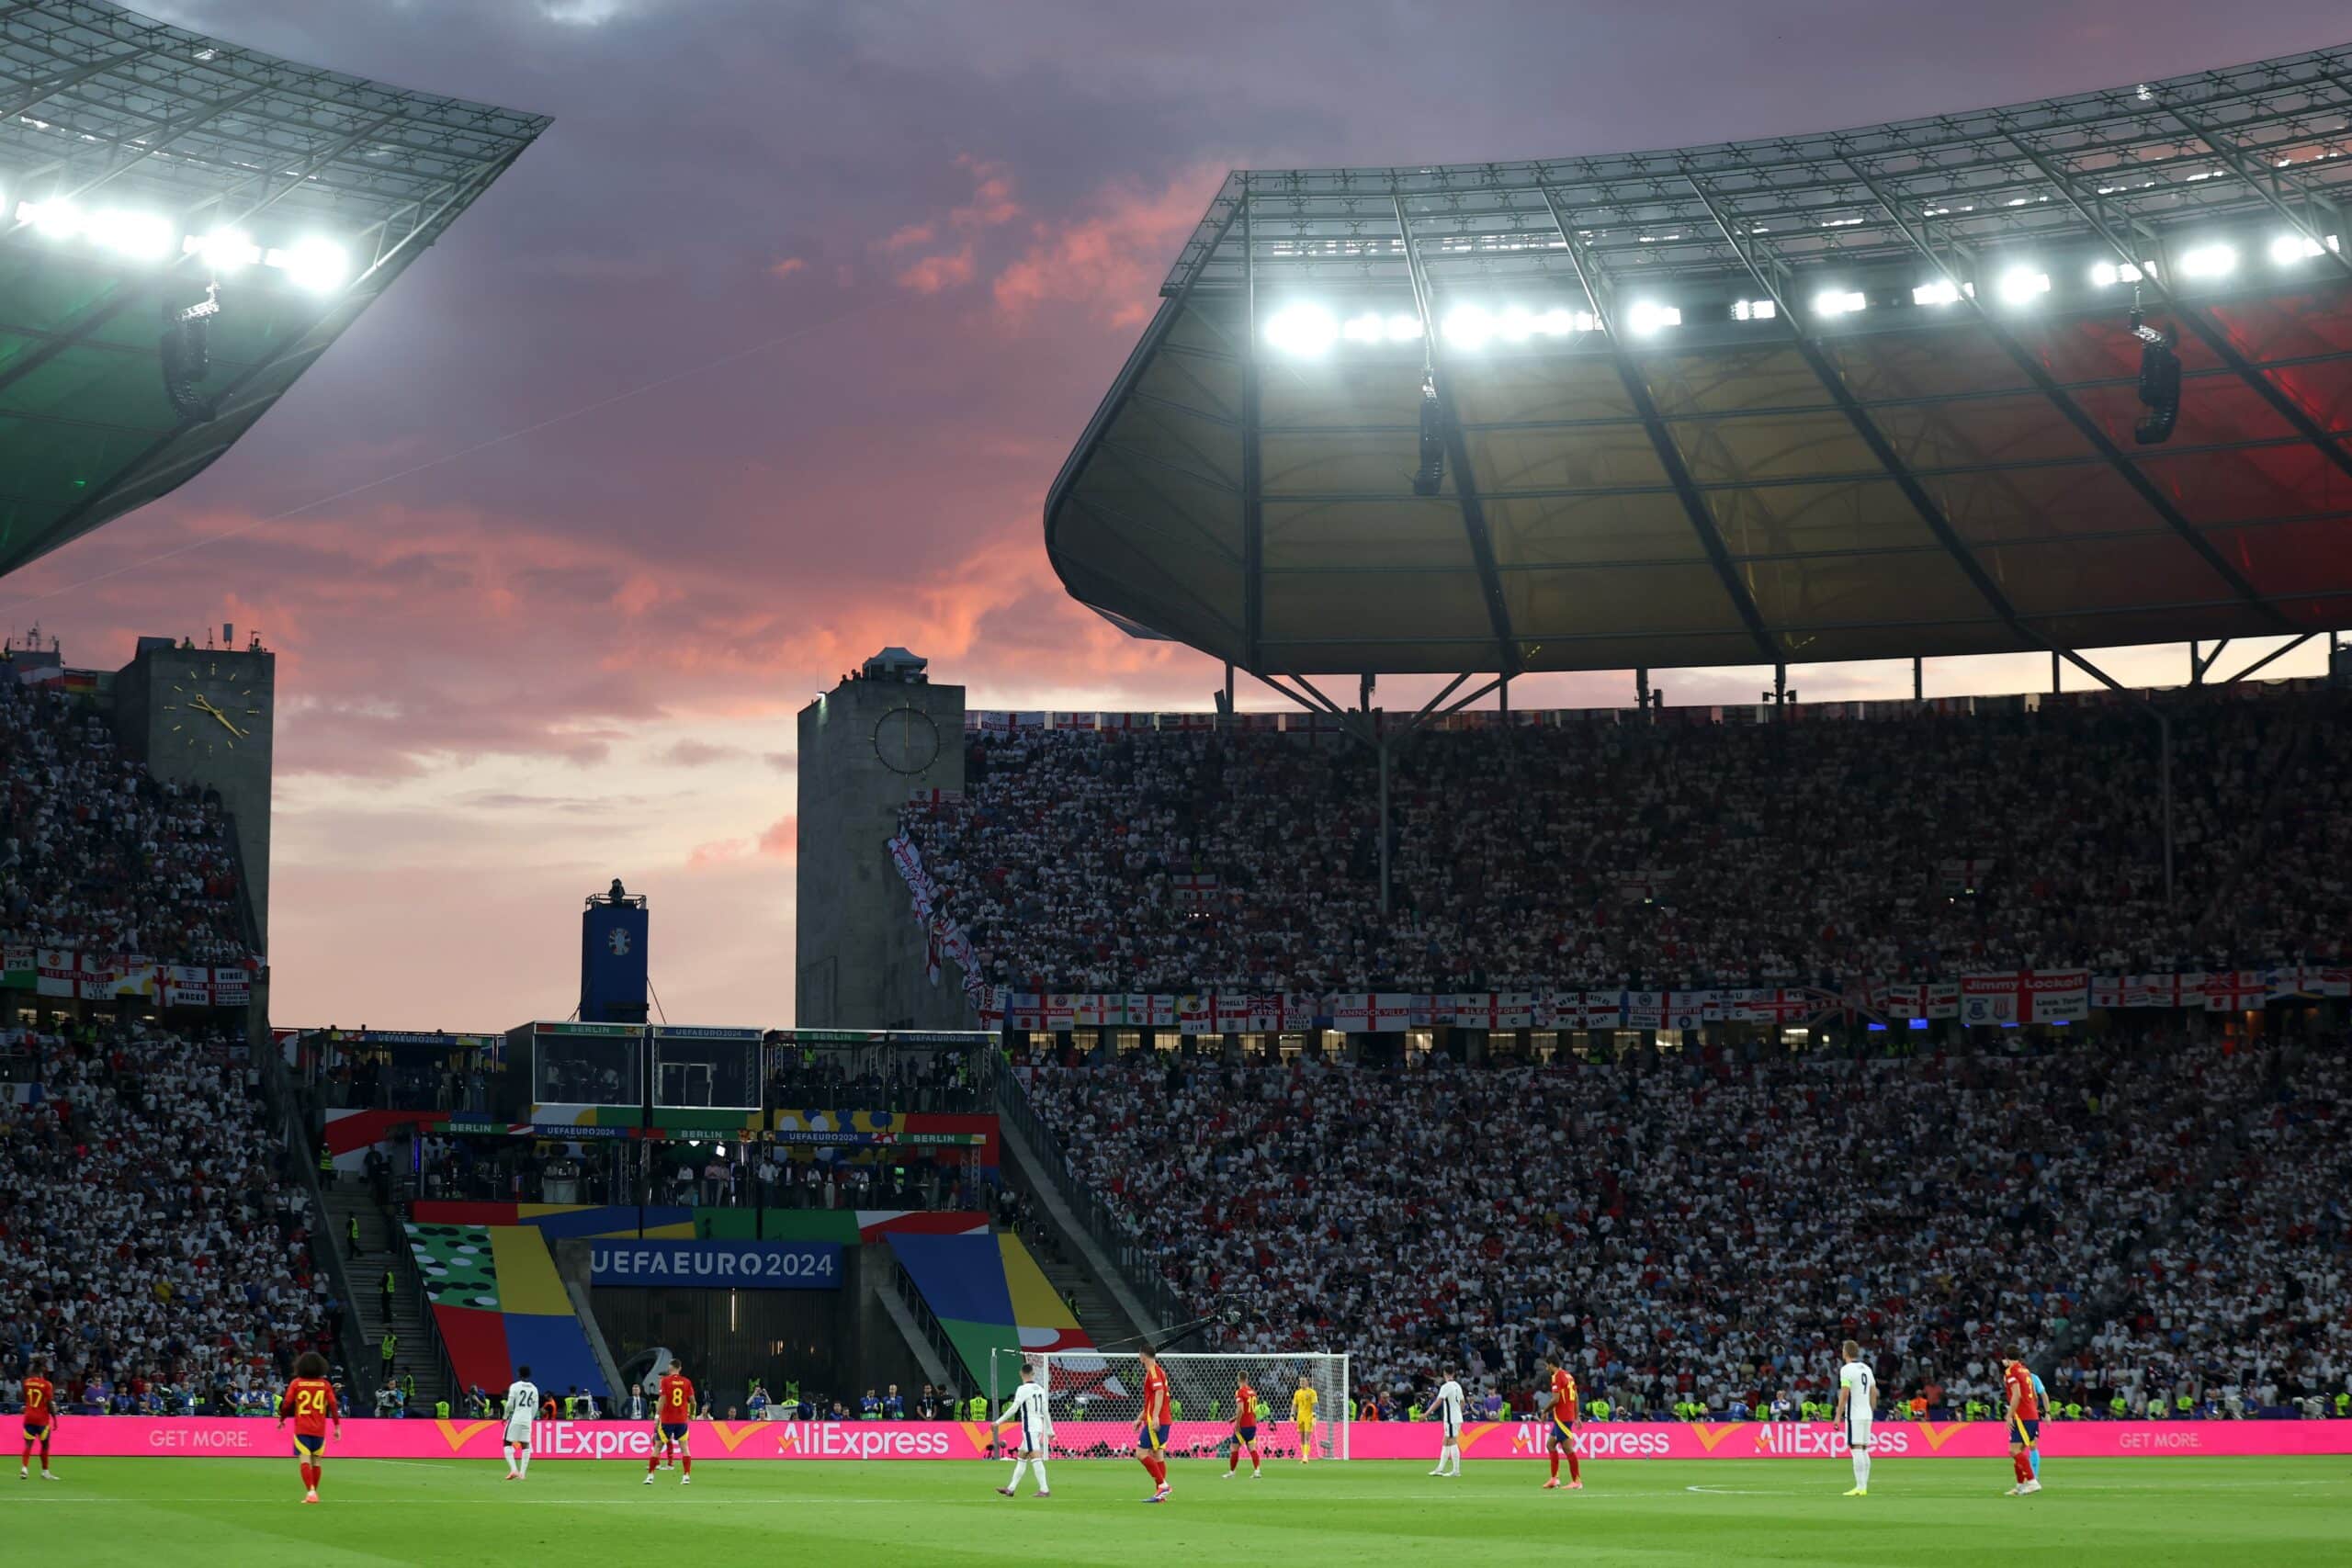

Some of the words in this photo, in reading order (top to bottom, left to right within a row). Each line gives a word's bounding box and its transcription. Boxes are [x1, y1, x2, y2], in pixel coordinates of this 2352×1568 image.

[571, 1025, 611, 1034] BERLIN
[812, 1032, 853, 1041] BERLIN
[449, 1123, 492, 1133] BERLIN
[681, 1130, 723, 1139] BERLIN
[912, 1134, 956, 1144] BERLIN
[1860, 1372, 1868, 1394] 9
[27, 1388, 43, 1408] 17
[297, 1390, 326, 1416] 24
[518, 1390, 534, 1407] 26
[672, 1387, 684, 1407] 8
[1032, 1393, 1044, 1413] 11
[1248, 1395, 1258, 1414] 10
[149, 1429, 189, 1448] GET
[193, 1429, 254, 1449] MORE.
[777, 1422, 949, 1460] AliExpress
[2119, 1432, 2151, 1449] GET
